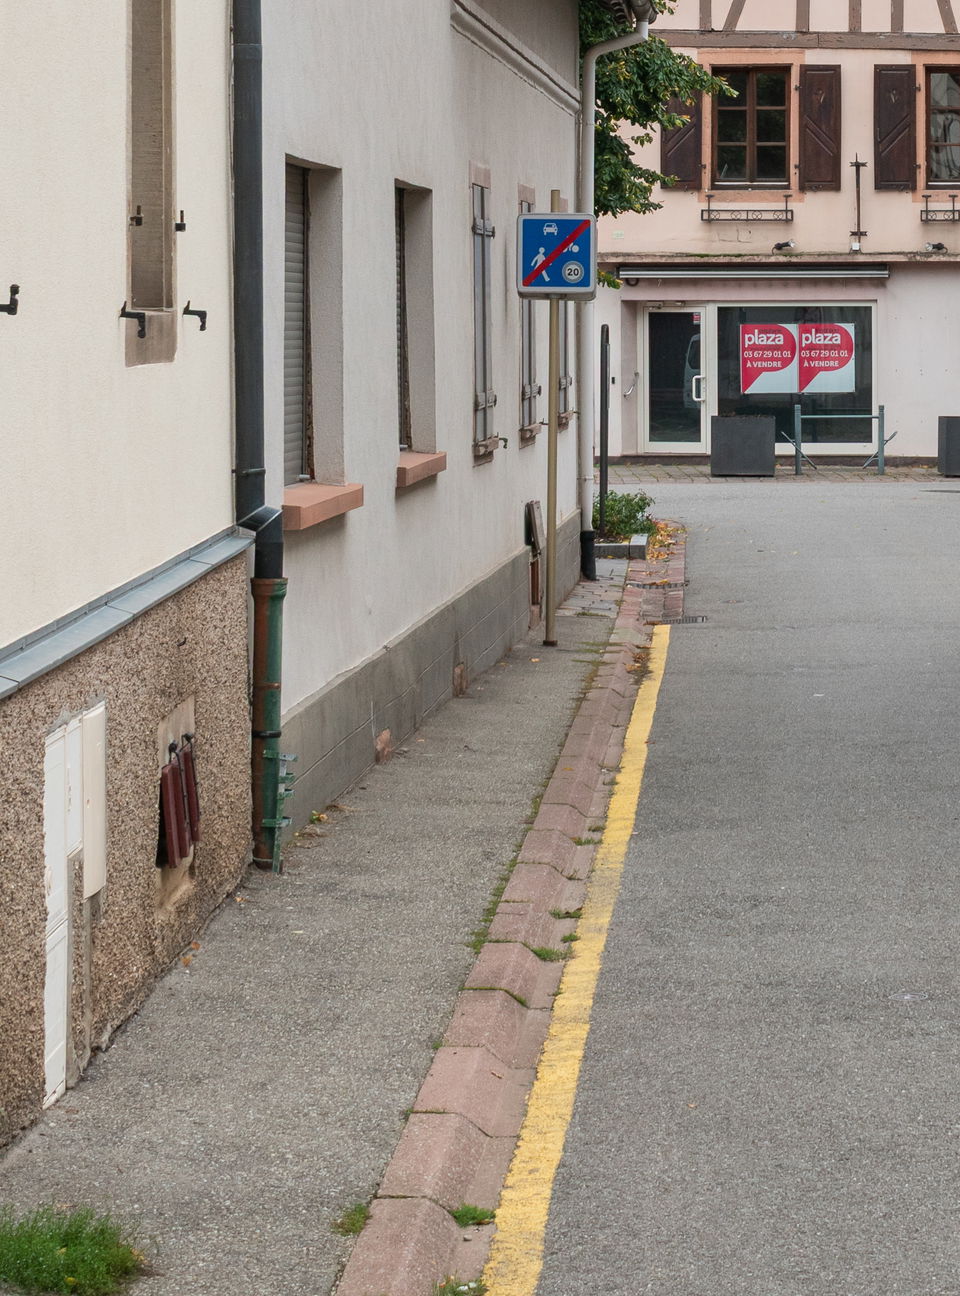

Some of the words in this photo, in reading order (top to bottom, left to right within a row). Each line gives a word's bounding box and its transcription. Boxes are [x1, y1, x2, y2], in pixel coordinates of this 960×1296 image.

[567, 268, 579, 276] 20
[745, 329, 784, 348] plaza
[802, 328, 841, 347] plaza
[743, 350, 753, 358] 03
[754, 350, 763, 358] 67
[763, 350, 772, 358] 29
[773, 350, 782, 358] 01
[782, 350, 791, 358] 01
[746, 360, 752, 368] À
[804, 359, 809, 367] À
